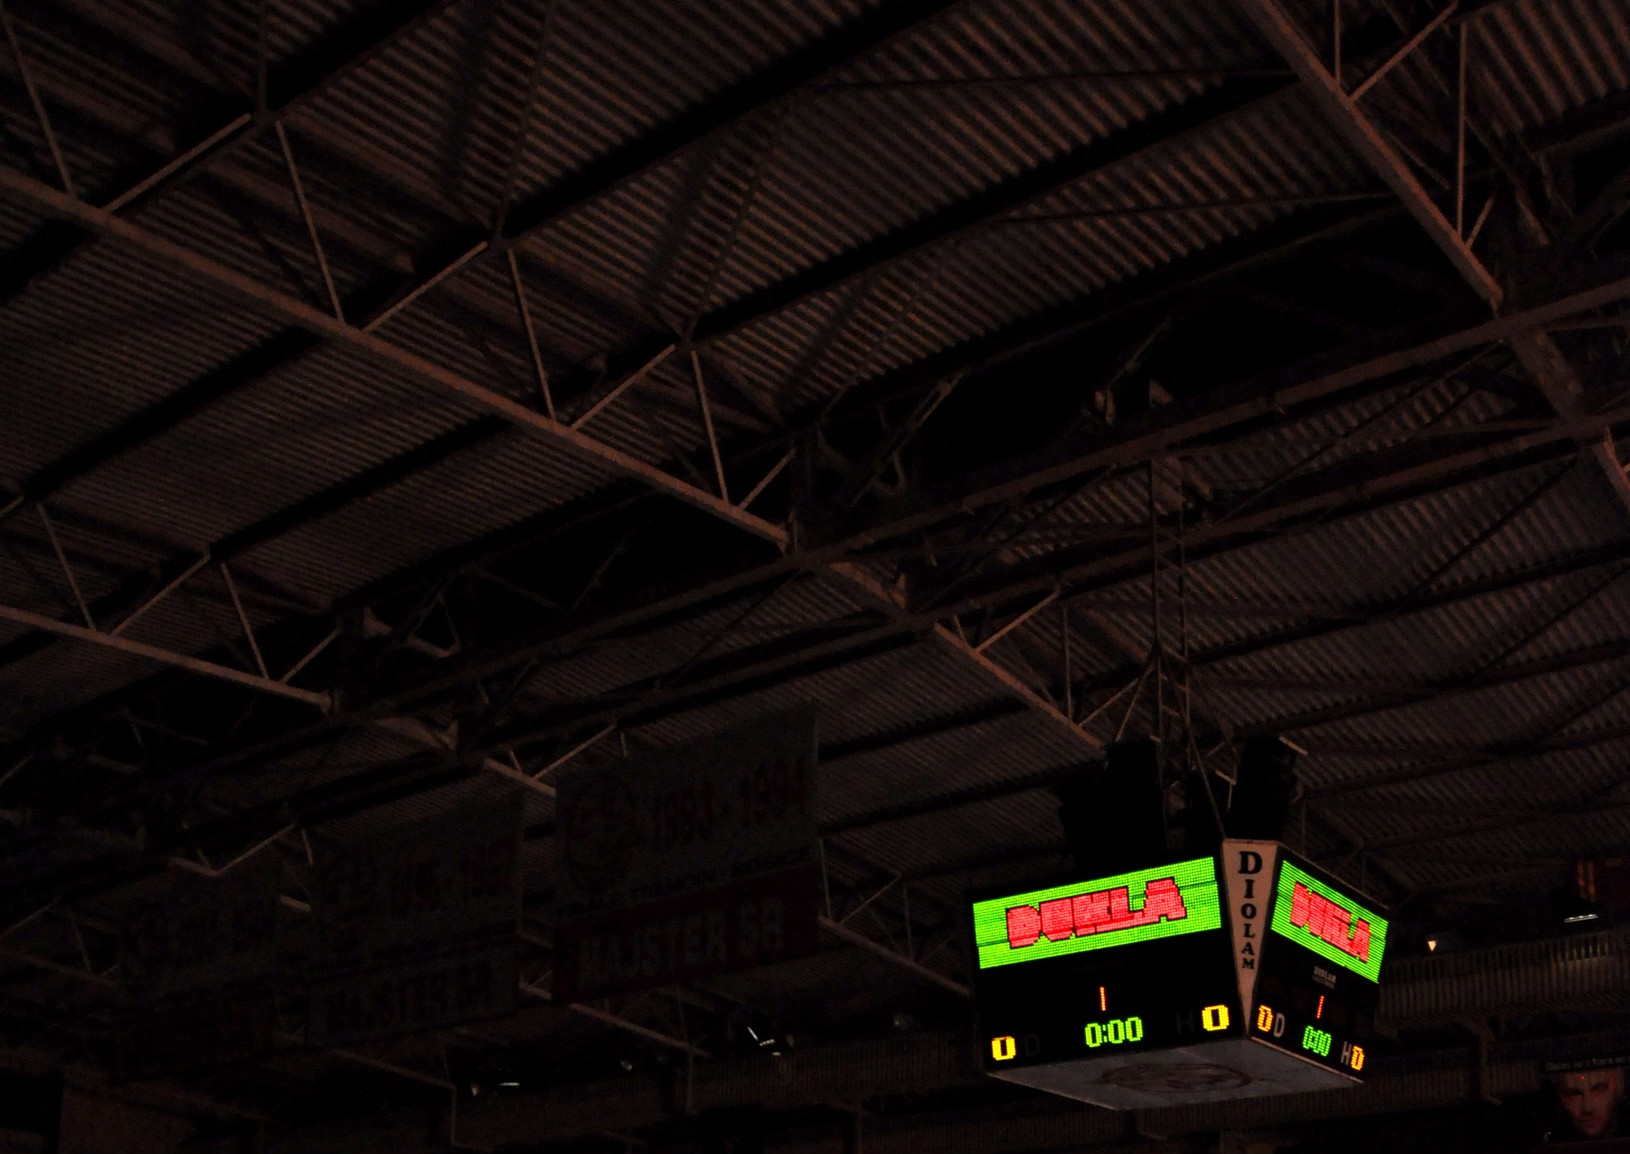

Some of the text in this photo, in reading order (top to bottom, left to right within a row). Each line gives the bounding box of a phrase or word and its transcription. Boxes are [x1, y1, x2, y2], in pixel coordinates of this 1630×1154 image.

[1006, 877, 1187, 950] DUKLA
[1238, 851, 1264, 970] DIOLAM
[1084, 1016, 1144, 1048] 0:00
